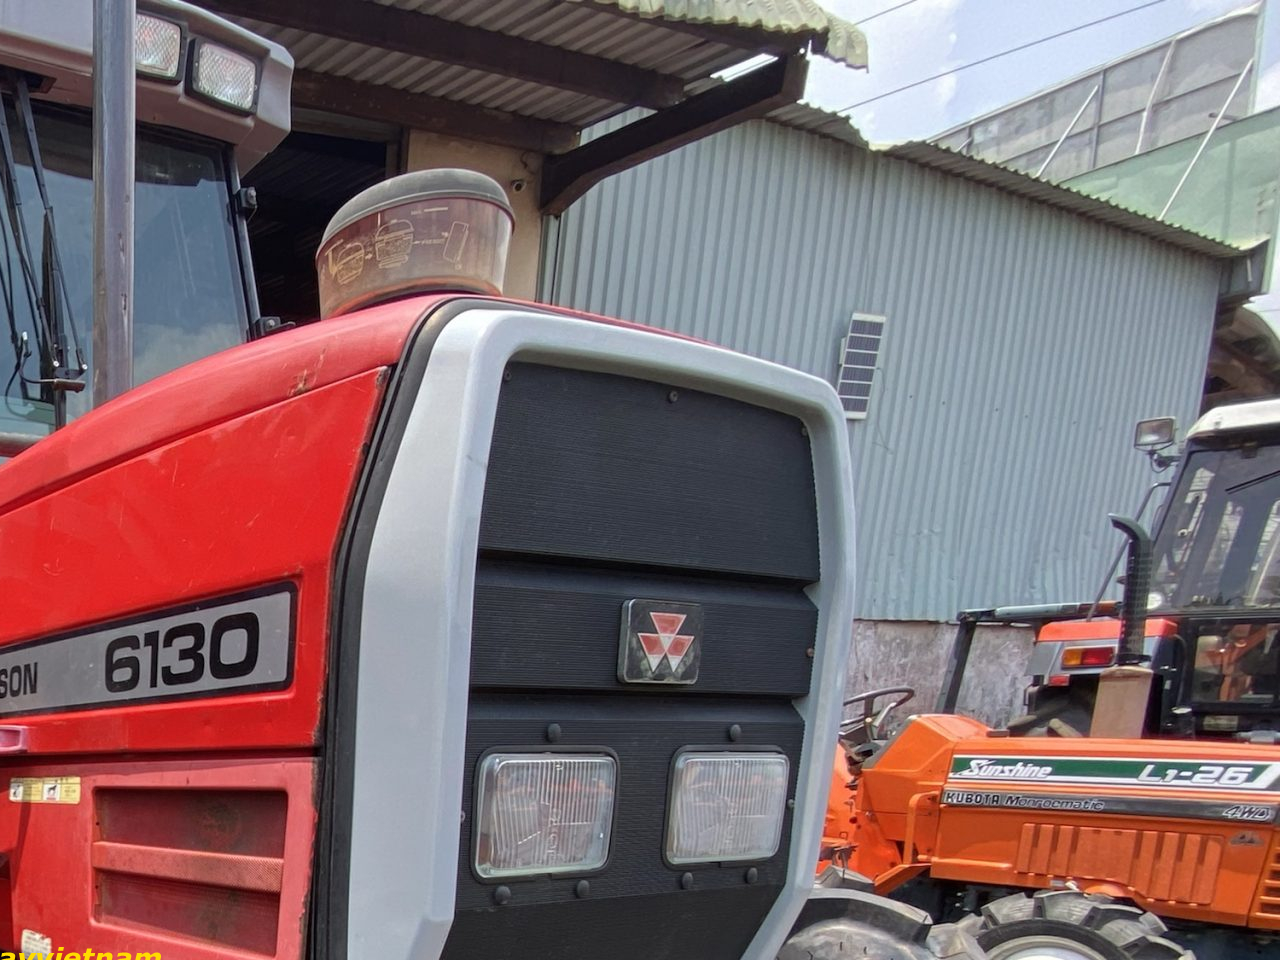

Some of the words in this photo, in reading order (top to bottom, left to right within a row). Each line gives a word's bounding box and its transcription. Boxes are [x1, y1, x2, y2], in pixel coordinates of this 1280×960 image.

[105, 611, 260, 693] 6130
[960, 759, 1053, 778] Sunshine
[945, 792, 1000, 805] KUBOTA
[1222, 804, 1271, 821] 4WD
